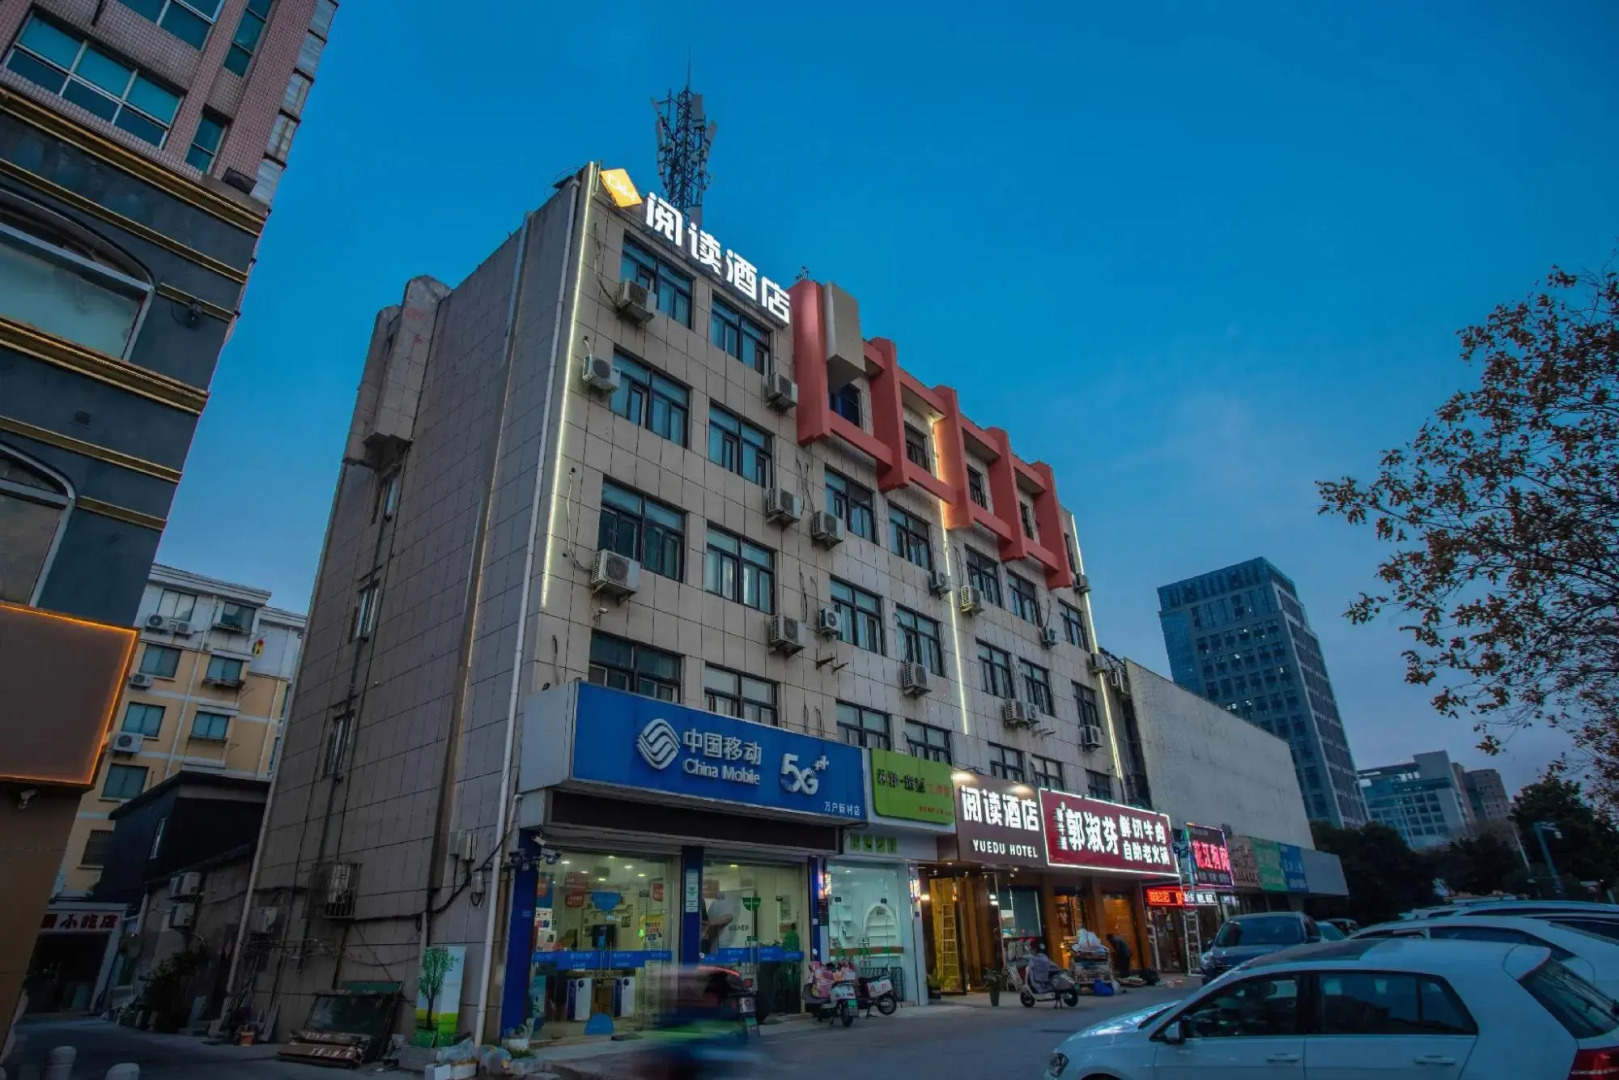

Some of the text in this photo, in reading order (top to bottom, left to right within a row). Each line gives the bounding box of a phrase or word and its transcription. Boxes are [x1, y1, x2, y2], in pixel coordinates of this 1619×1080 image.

[645, 190, 791, 325] 阅读酒店
[682, 728, 763, 766] 中国移动
[682, 758, 761, 787] China Mobile
[960, 786, 1040, 832] 阅读酒店
[1064, 808, 1119, 855] 郭淑芬
[1119, 814, 1166, 845] 鲜切牛肉
[972, 839, 1039, 859] YUEDU HOTEL
[1123, 841, 1171, 866] 自助老火锅
